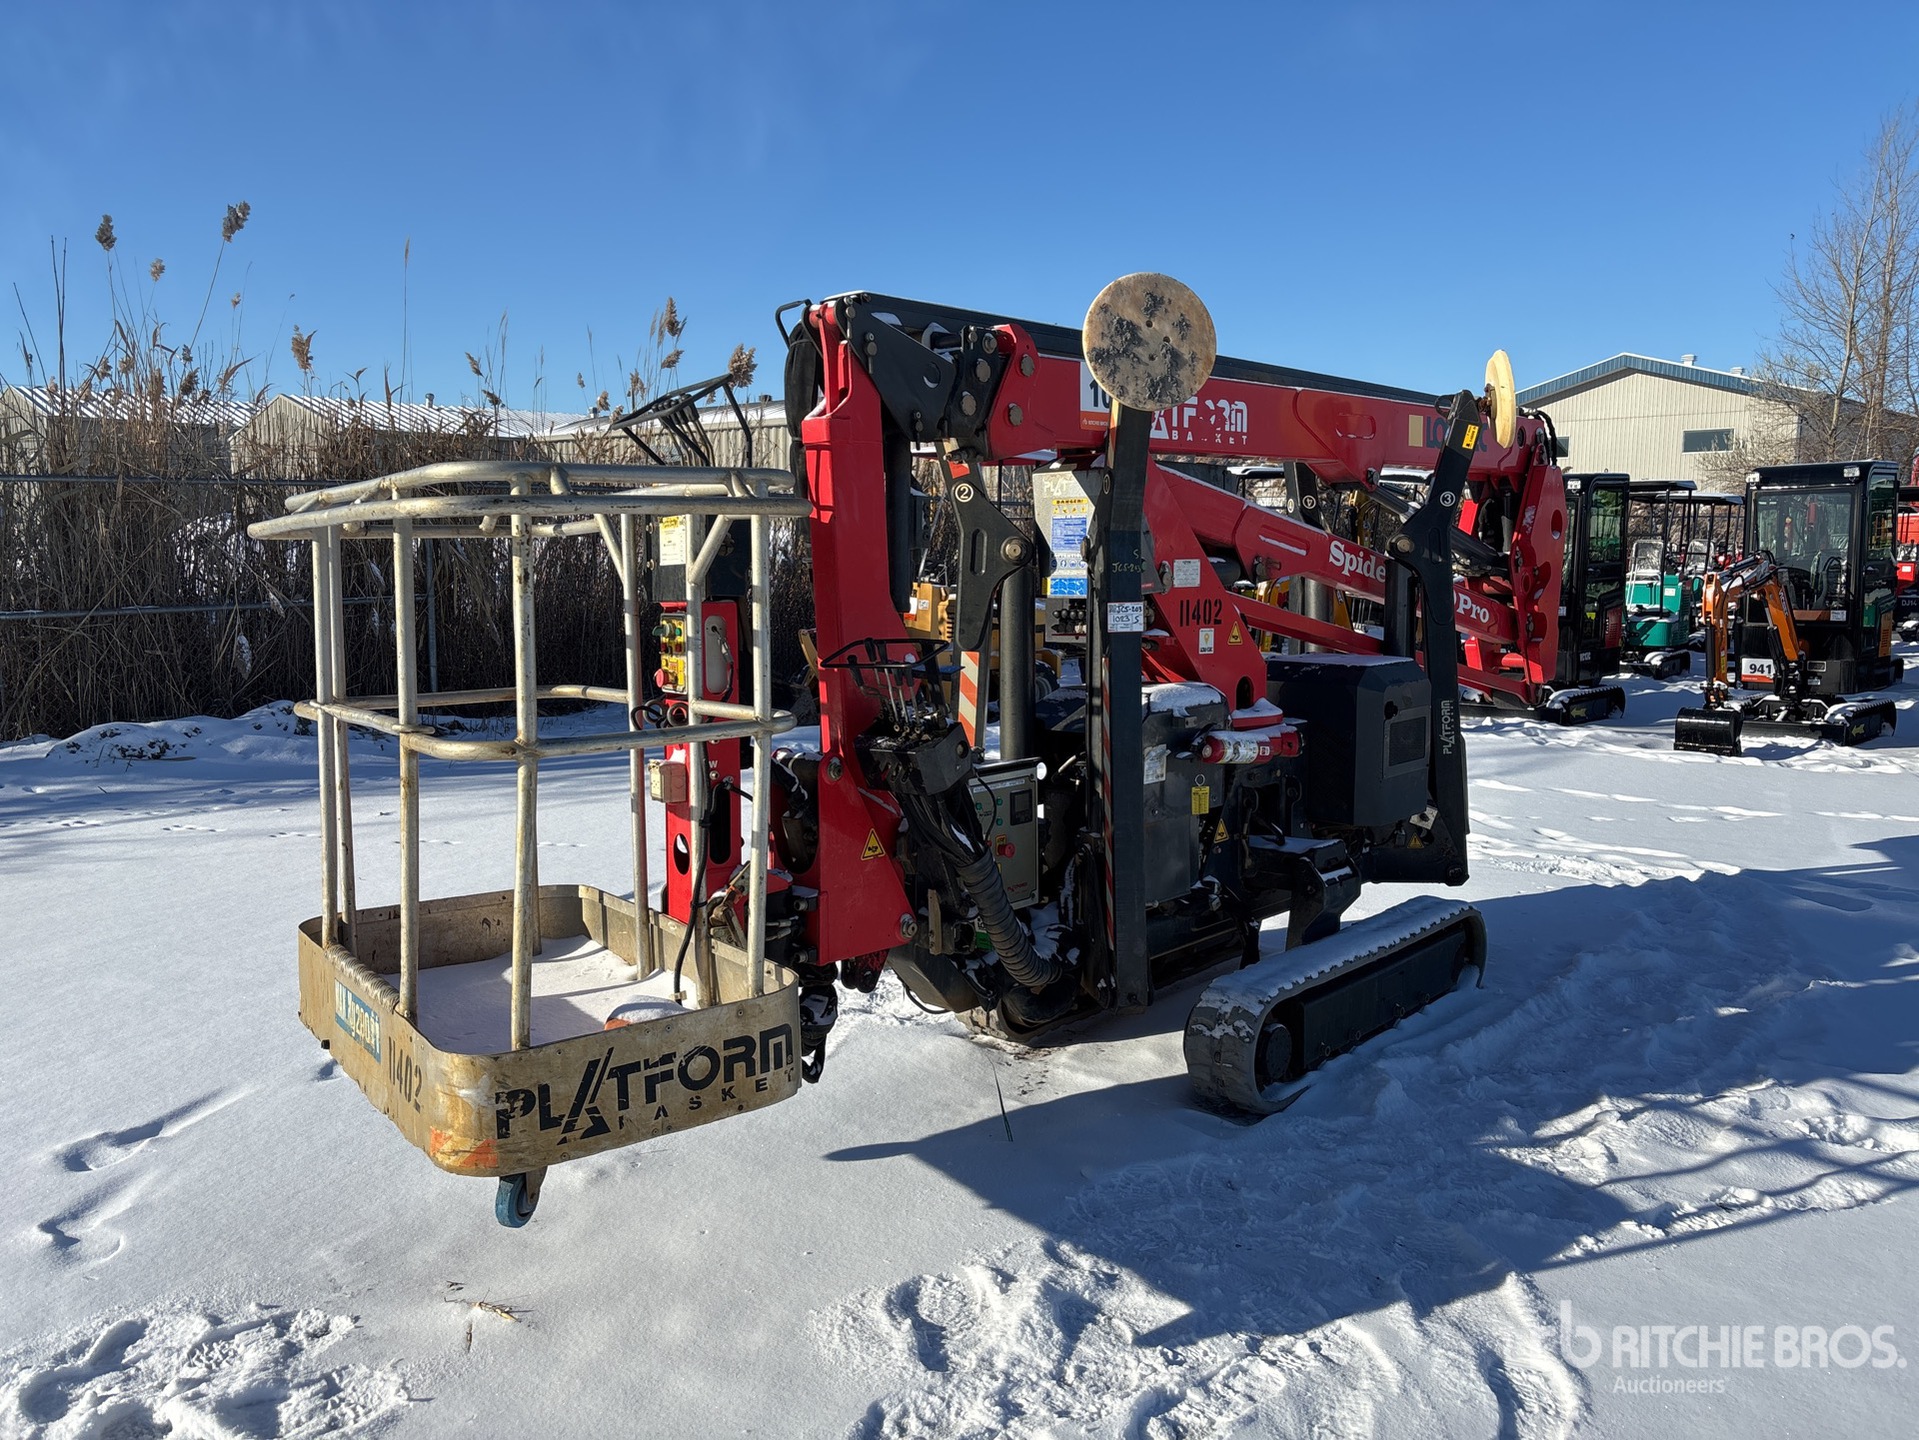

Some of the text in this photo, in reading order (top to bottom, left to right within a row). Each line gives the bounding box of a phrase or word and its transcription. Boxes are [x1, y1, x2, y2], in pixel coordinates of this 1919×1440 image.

[1328, 540, 1386, 584] Spide
[1179, 599, 1222, 627] 11402
[1456, 592, 1490, 623] Pro
[1439, 700, 1455, 755] PLATFORM
[388, 1036, 423, 1114] 11402
[495, 1023, 794, 1145] PLATFORM
[619, 1066, 795, 1131] ASKET
